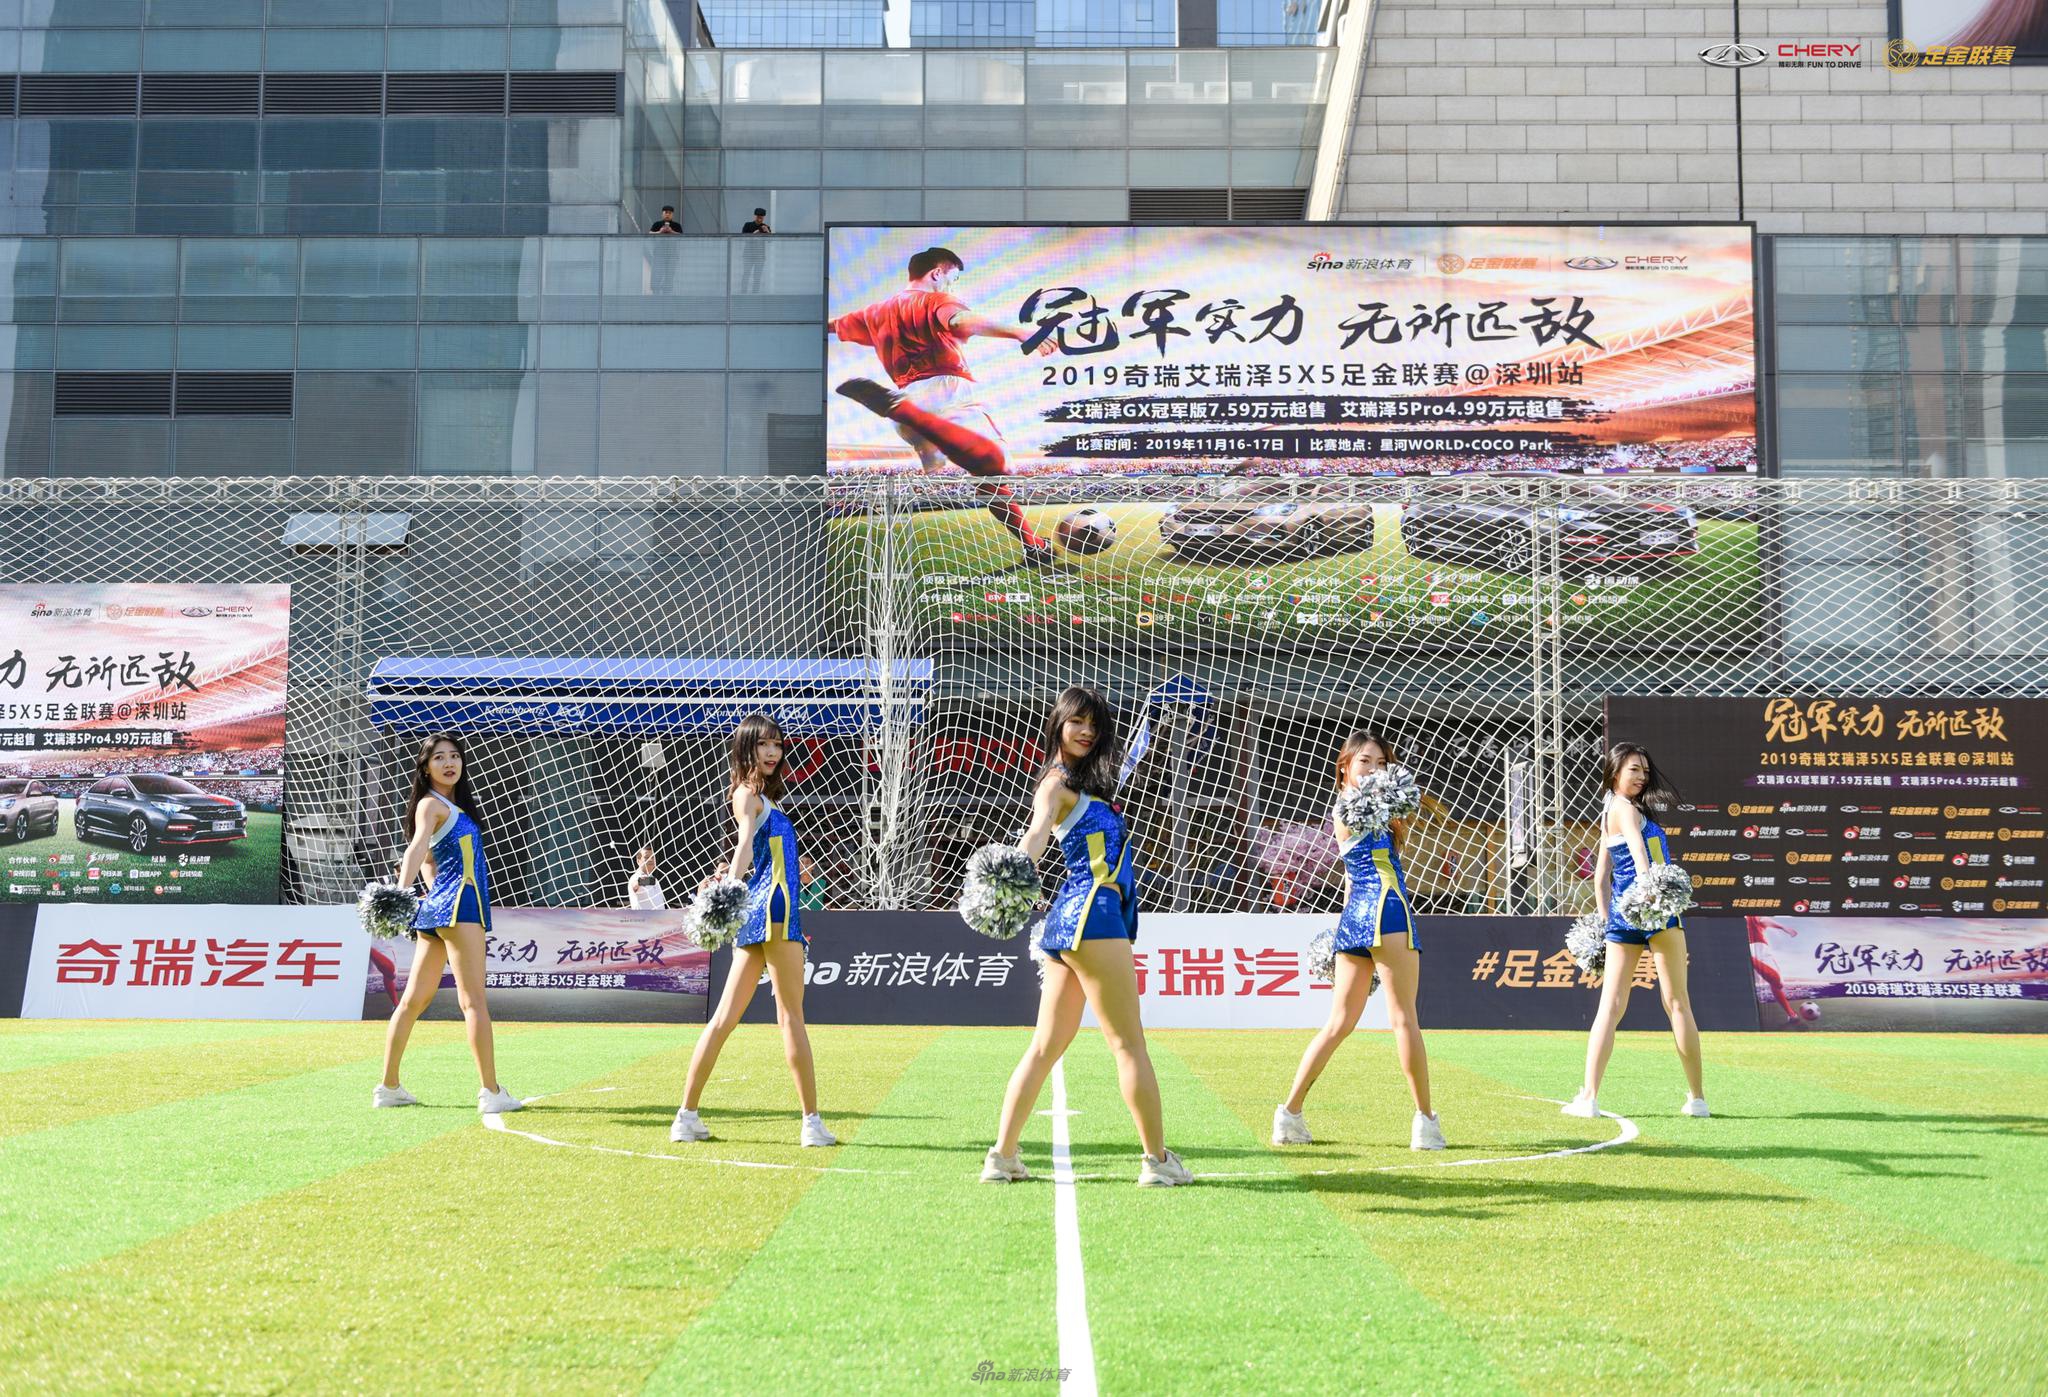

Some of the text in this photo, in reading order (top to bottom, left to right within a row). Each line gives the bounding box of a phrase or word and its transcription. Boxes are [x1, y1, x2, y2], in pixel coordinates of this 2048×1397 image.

[1305, 256, 1414, 273] sina 新浪体育
[1624, 254, 1688, 265] CHERY
[1019, 286, 1604, 357] 冠军实力 无所匹敌
[1043, 362, 1584, 388] 2019奇瑞艾瑞泽5X5足金联赛@深圳站
[1066, 401, 1564, 420] 艾瑞泽GX冠军版7.59万元起售 艾瑞泽5Pro4.99万元起售
[1520, 438, 1553, 452] Park
[46, 651, 201, 692] 无所匹敌
[0, 702, 187, 722] 5X5足金联赛@深圳站
[556, 704, 587, 720] 1664
[1764, 697, 2007, 744] 冠军实力 无所匹敌
[0, 731, 173, 747] 元起售 艾瑞泽5Pro4.99万元起售
[1760, 751, 2014, 767] 2019奇瑞艾瑞泽5X5足金联赛@深圳站
[56, 938, 343, 987] 奇瑞汽车
[557, 937, 666, 966] 无所匹敌
[1814, 942, 1924, 976] 冠军实力
[845, 951, 1019, 987] 新浪体育
[1132, 947, 1335, 997] 瑞汽
[1845, 982, 2023, 998] 2019奇瑞艾瑞泽5X5足金联赛
